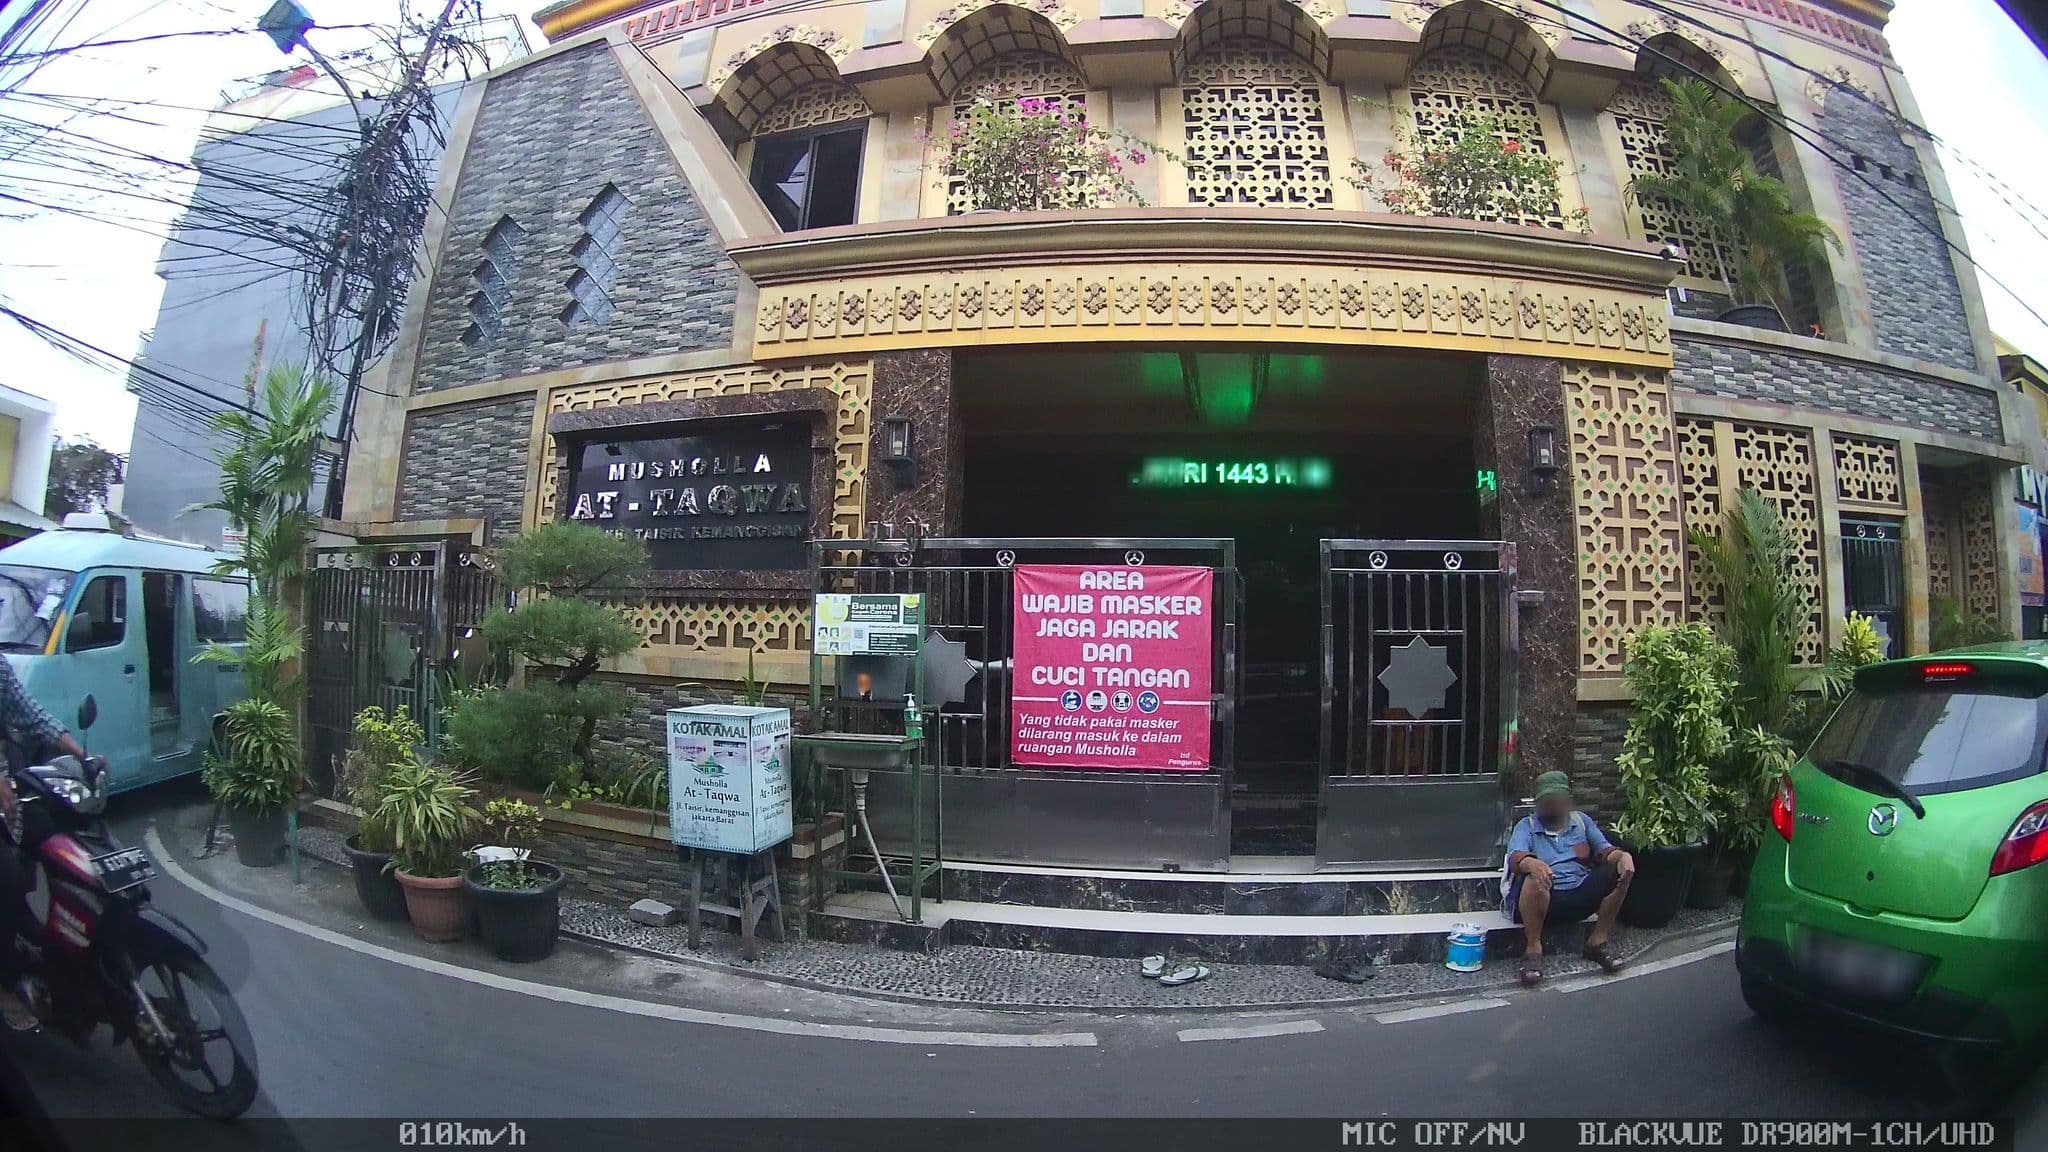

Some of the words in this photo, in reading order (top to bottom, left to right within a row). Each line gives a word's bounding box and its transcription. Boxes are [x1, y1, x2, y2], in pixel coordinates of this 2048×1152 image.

[608, 454, 772, 481] MUSHOLLA
[1216, 463, 1269, 484] 1443
[650, 483, 808, 517] TAQWA
[1079, 570, 1144, 590] AREA
[852, 602, 898, 610] Bersama
[1022, 594, 1094, 614] WAJIB
[1100, 595, 1202, 615] MASKER
[1036, 618, 1096, 638] JAGA
[1102, 619, 1179, 639] JARAK
[1082, 643, 1132, 662] DAN
[1031, 665, 1085, 686] CUCI
[1092, 667, 1190, 688] TANGAN
[673, 722, 712, 737] KOTAK
[712, 725, 748, 738] AMAL
[1019, 713, 1051, 728] Yang
[1054, 715, 1087, 727] tidak
[1090, 716, 1126, 729] pakai
[1129, 717, 1179, 729] masker
[1018, 728, 1072, 742] dilarang
[1075, 730, 1119, 741] masuk
[1122, 730, 1139, 742] ke
[1141, 731, 1182, 743] dalam
[1017, 743, 1072, 756] ruangan
[1075, 743, 1136, 757] Musholla
[694, 778, 728, 788] Musholla
[704, 788, 740, 805] Taqwa
